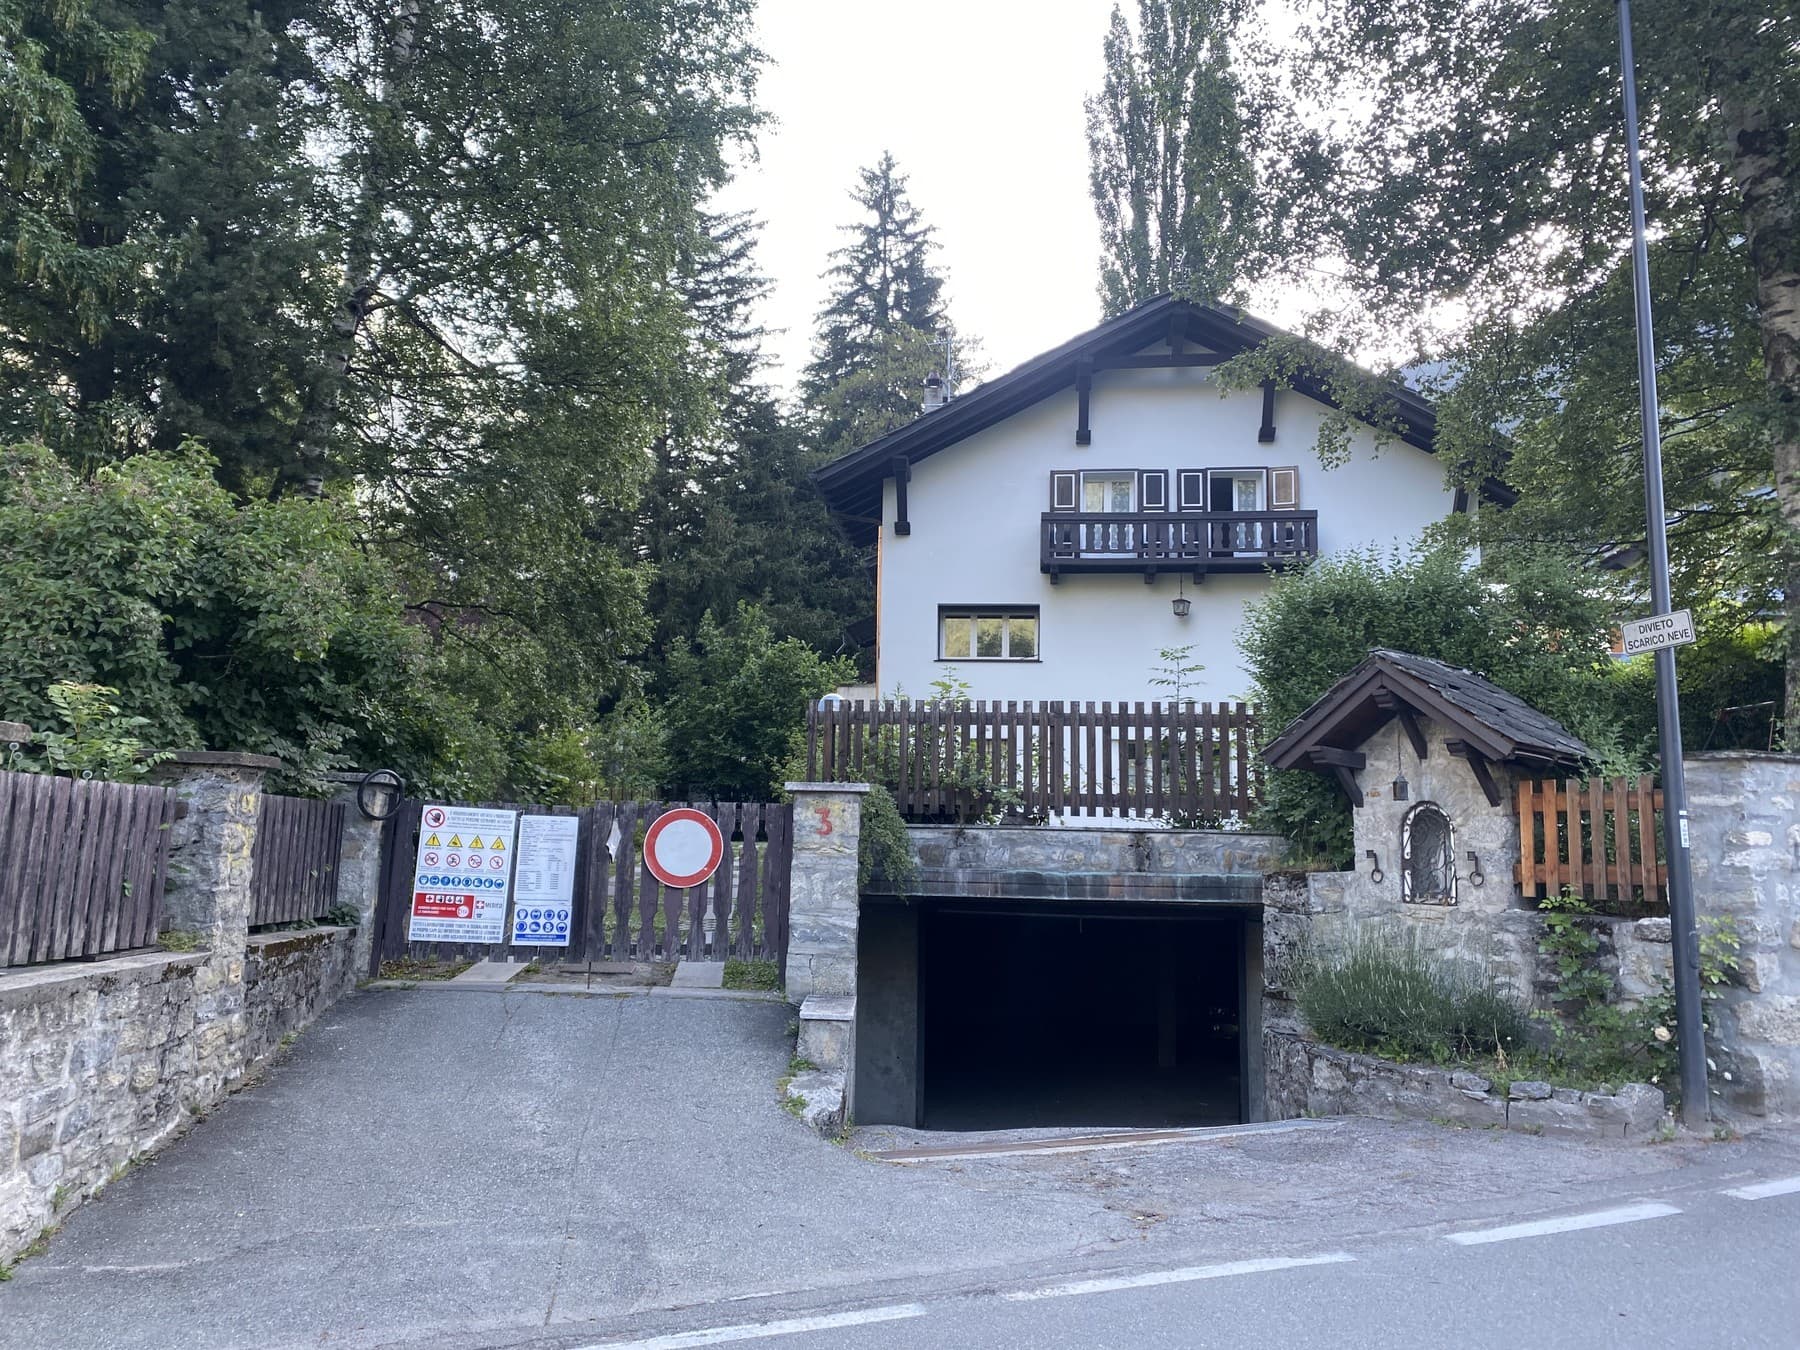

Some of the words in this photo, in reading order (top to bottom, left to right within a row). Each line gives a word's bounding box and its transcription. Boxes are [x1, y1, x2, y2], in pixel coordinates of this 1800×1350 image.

[1638, 619, 1673, 634] DIVIETO
[1628, 634, 1664, 650] SCARICO
[1667, 629, 1690, 641] NEVE
[815, 807, 833, 836] 3
